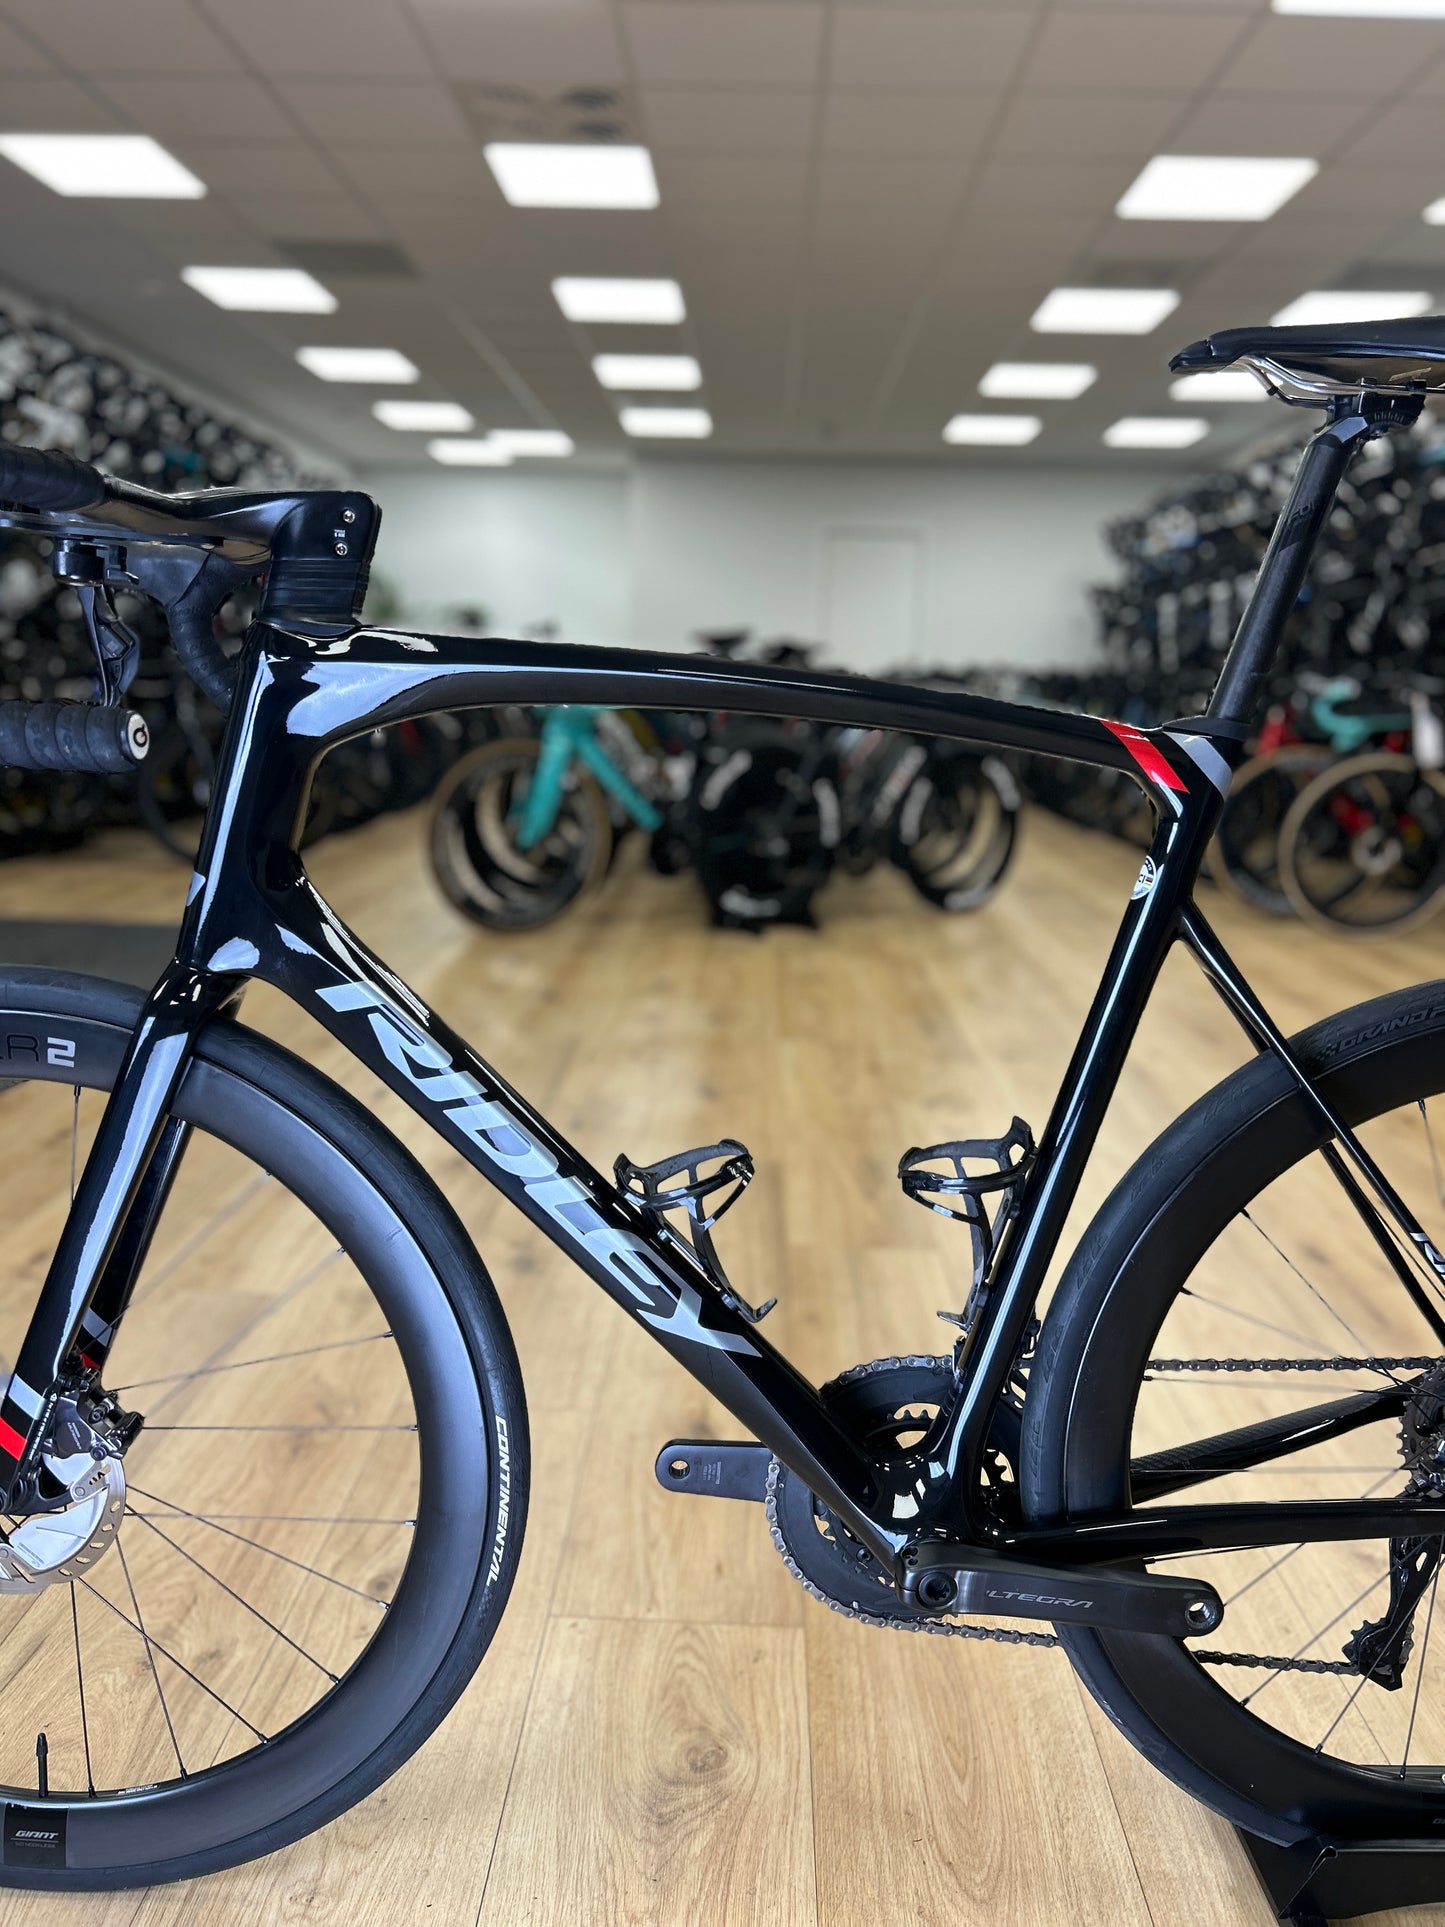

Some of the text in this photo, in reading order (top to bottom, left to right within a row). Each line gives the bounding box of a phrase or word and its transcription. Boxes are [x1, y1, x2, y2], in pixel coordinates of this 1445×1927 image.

[315, 980, 762, 1357] RIDLEY
[486, 1414, 511, 1587] CONTINENTAL
[986, 1590, 1094, 1608] LTEGRA
[15, 1830, 59, 1839] GIANT
